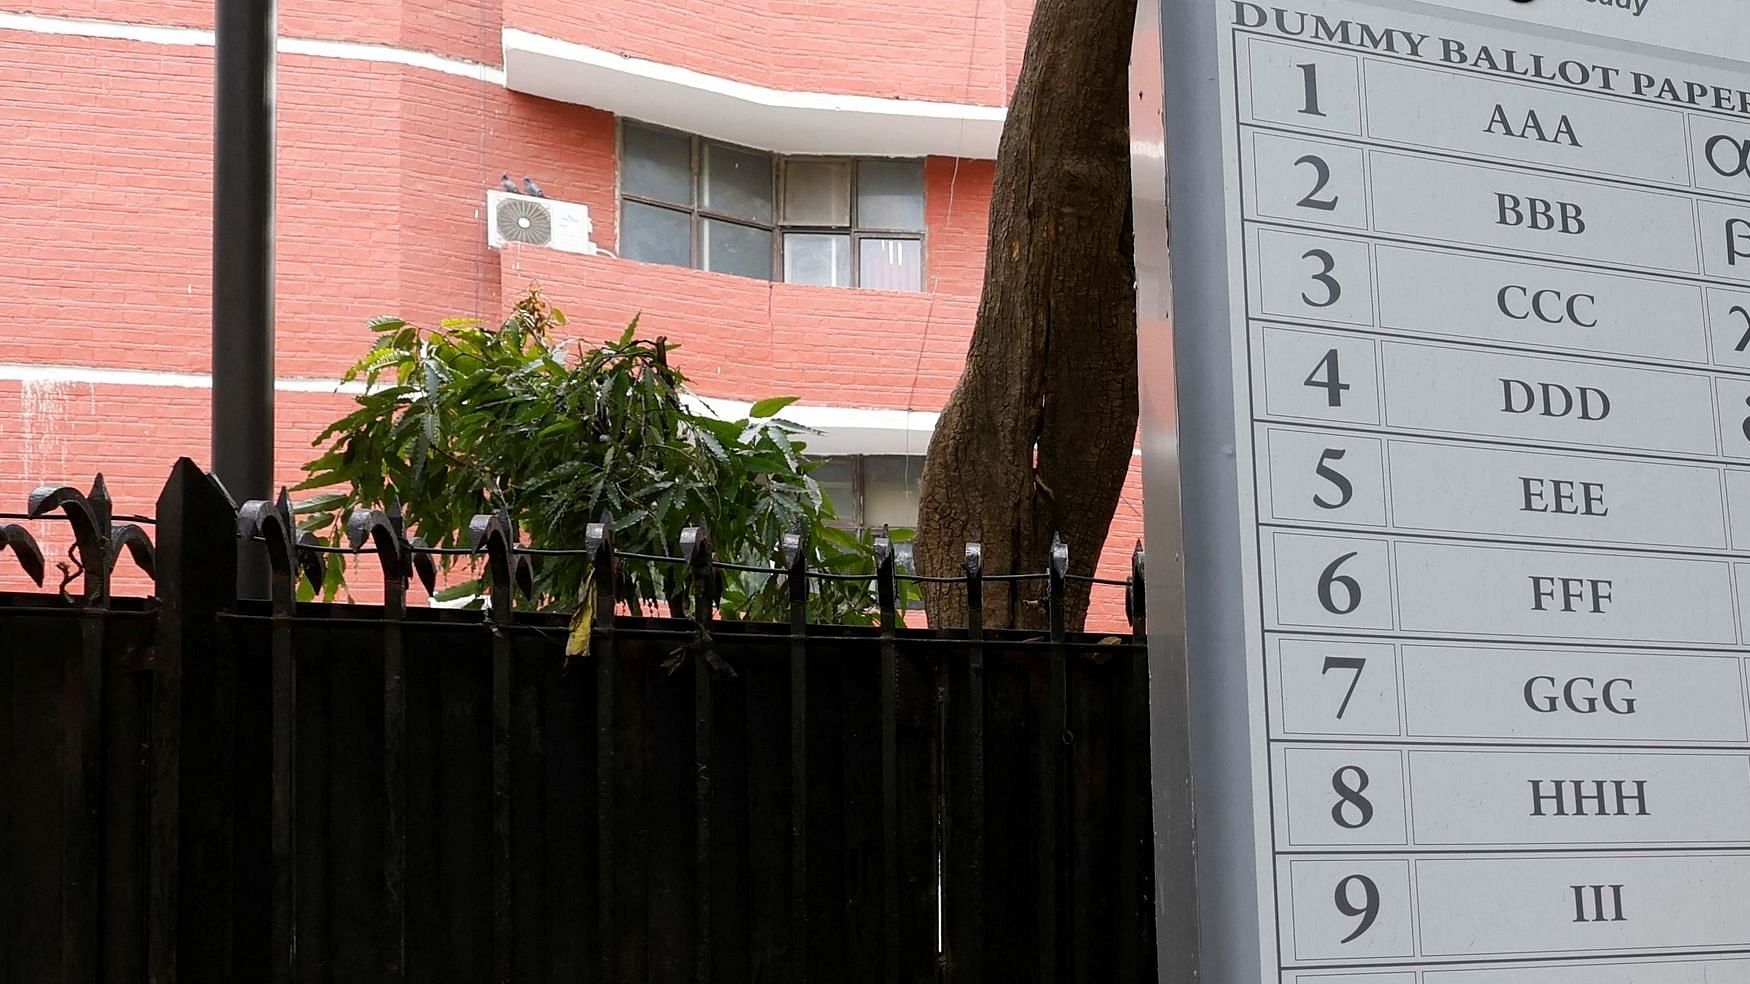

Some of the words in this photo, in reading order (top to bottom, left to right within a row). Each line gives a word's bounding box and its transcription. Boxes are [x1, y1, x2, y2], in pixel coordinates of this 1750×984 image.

[1232, 0, 1429, 58] DUMMY
[1438, 37, 1619, 91] BALLOT
[1296, 64, 1327, 117] 1
[1483, 104, 1583, 147] AAA
[1294, 155, 1338, 211] 2
[1494, 193, 1585, 234] BBB
[1302, 249, 1341, 307] 3
[1497, 286, 1597, 327] CCC
[1304, 349, 1350, 407] 4
[1499, 379, 1610, 420] DDD
[1313, 448, 1352, 509] 5
[1519, 477, 1608, 516] EEE
[1318, 552, 1361, 614] 6
[1528, 576, 1612, 613] FFF
[1322, 656, 1366, 719] 7
[1524, 676, 1636, 714] GGG
[1332, 766, 1373, 828] 8
[1528, 780, 1651, 816] HHH
[1335, 874, 1379, 944] 9
[1570, 885, 1627, 922] III
